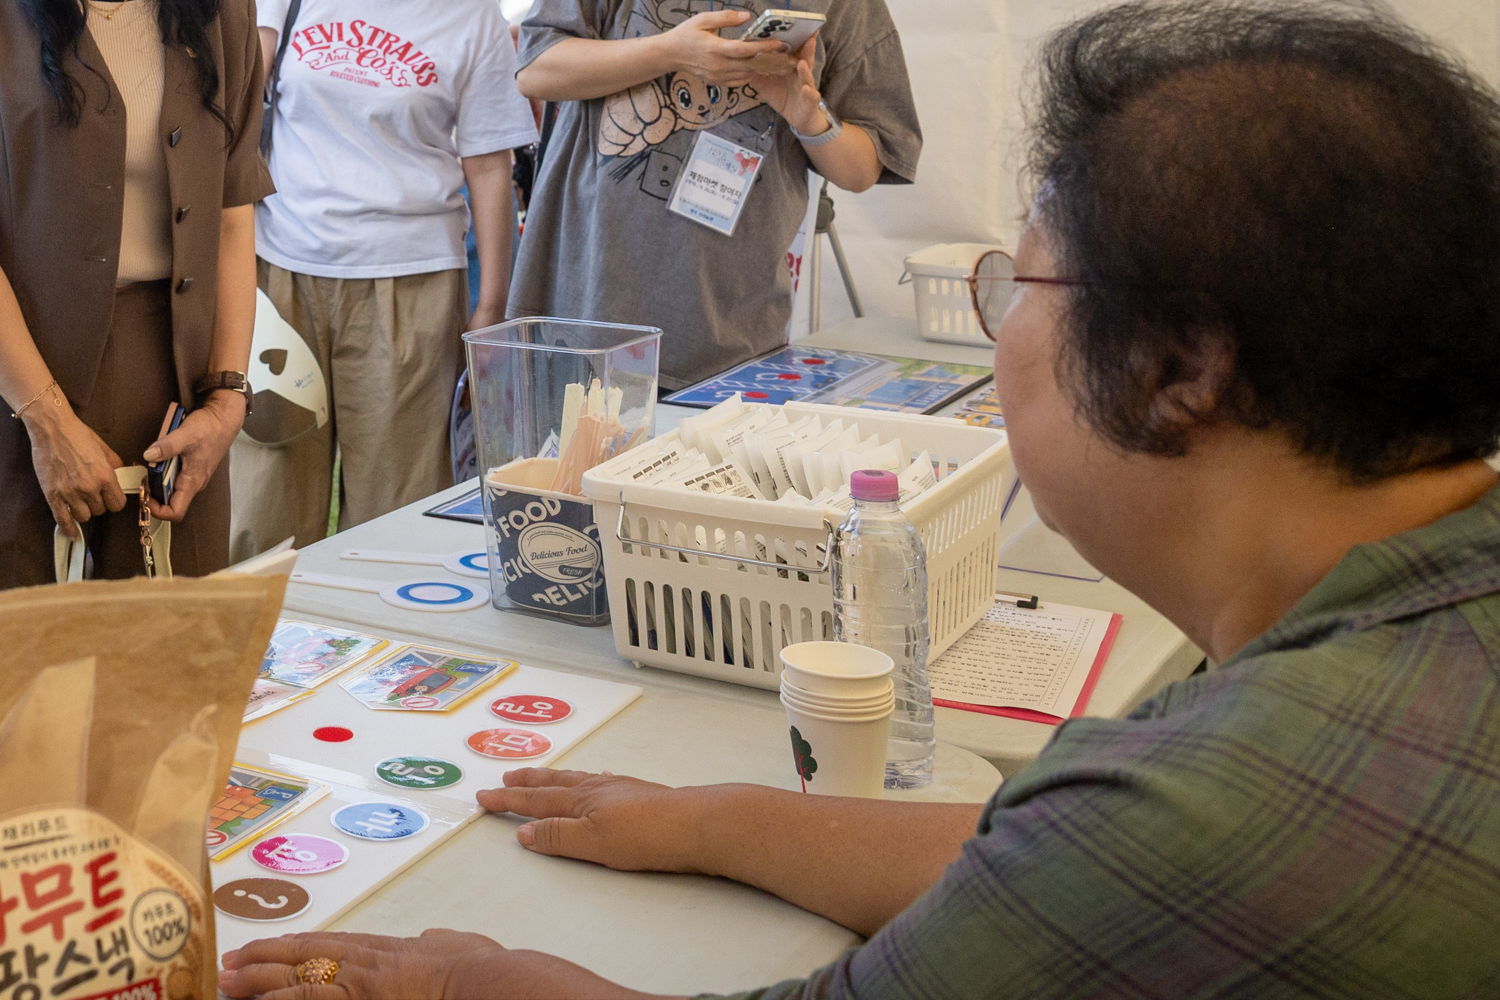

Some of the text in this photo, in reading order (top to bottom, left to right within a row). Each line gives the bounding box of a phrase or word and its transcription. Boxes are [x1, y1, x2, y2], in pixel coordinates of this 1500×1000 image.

[291, 19, 439, 87] LEVI STRAUSS
[324, 51, 351, 64] And
[497, 498, 562, 539] FOOD
[530, 544, 588, 561] Delicious Food
[562, 566, 583, 576] FRESH
[143, 918, 186, 948] 100%
